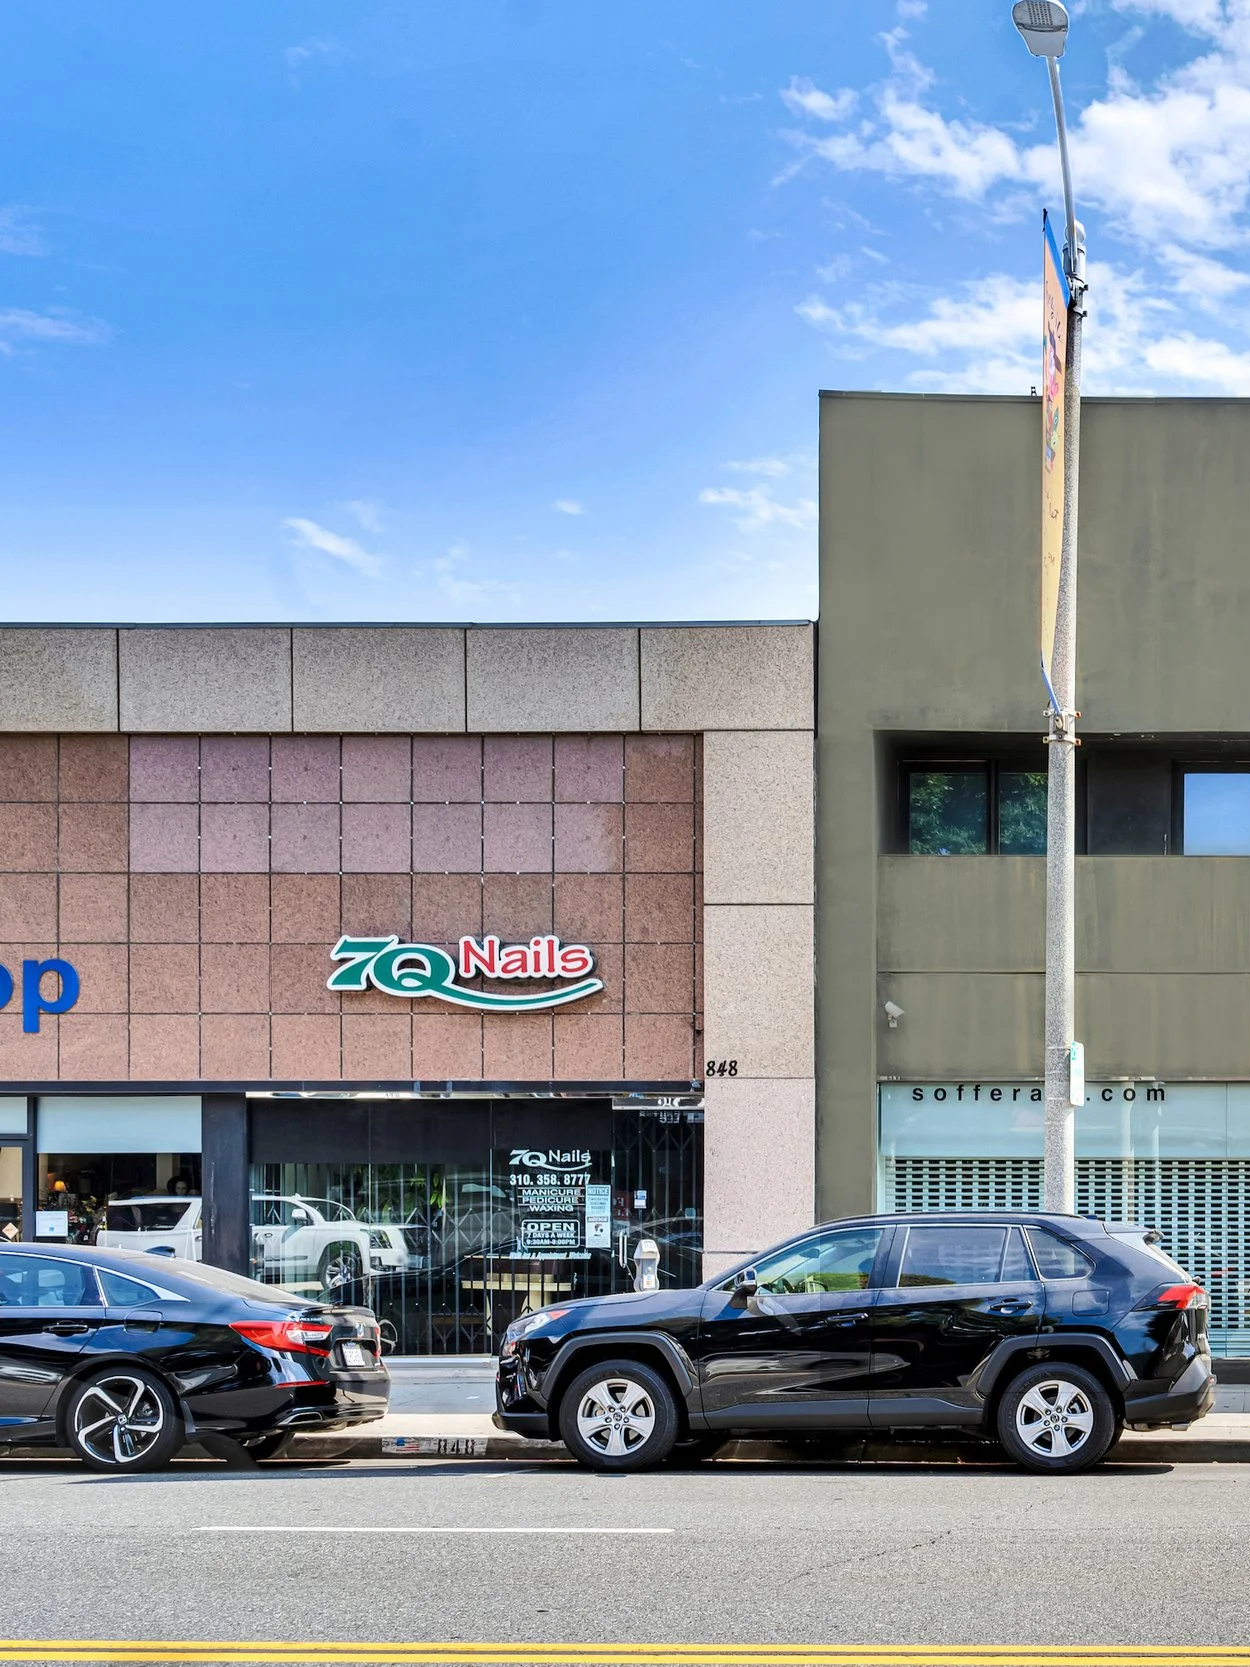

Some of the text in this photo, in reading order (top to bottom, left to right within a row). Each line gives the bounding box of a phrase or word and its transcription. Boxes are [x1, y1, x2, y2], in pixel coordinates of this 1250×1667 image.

[459, 935, 594, 979] Nails
[0, 958, 80, 1033] p
[705, 1060, 738, 1077] 848
[911, 1084, 1166, 1102] soffera.com
[508, 1149, 592, 1167] 7Q Nails
[509, 1173, 591, 1186] 310. 358. 8777
[526, 1222, 575, 1231] OPEN
